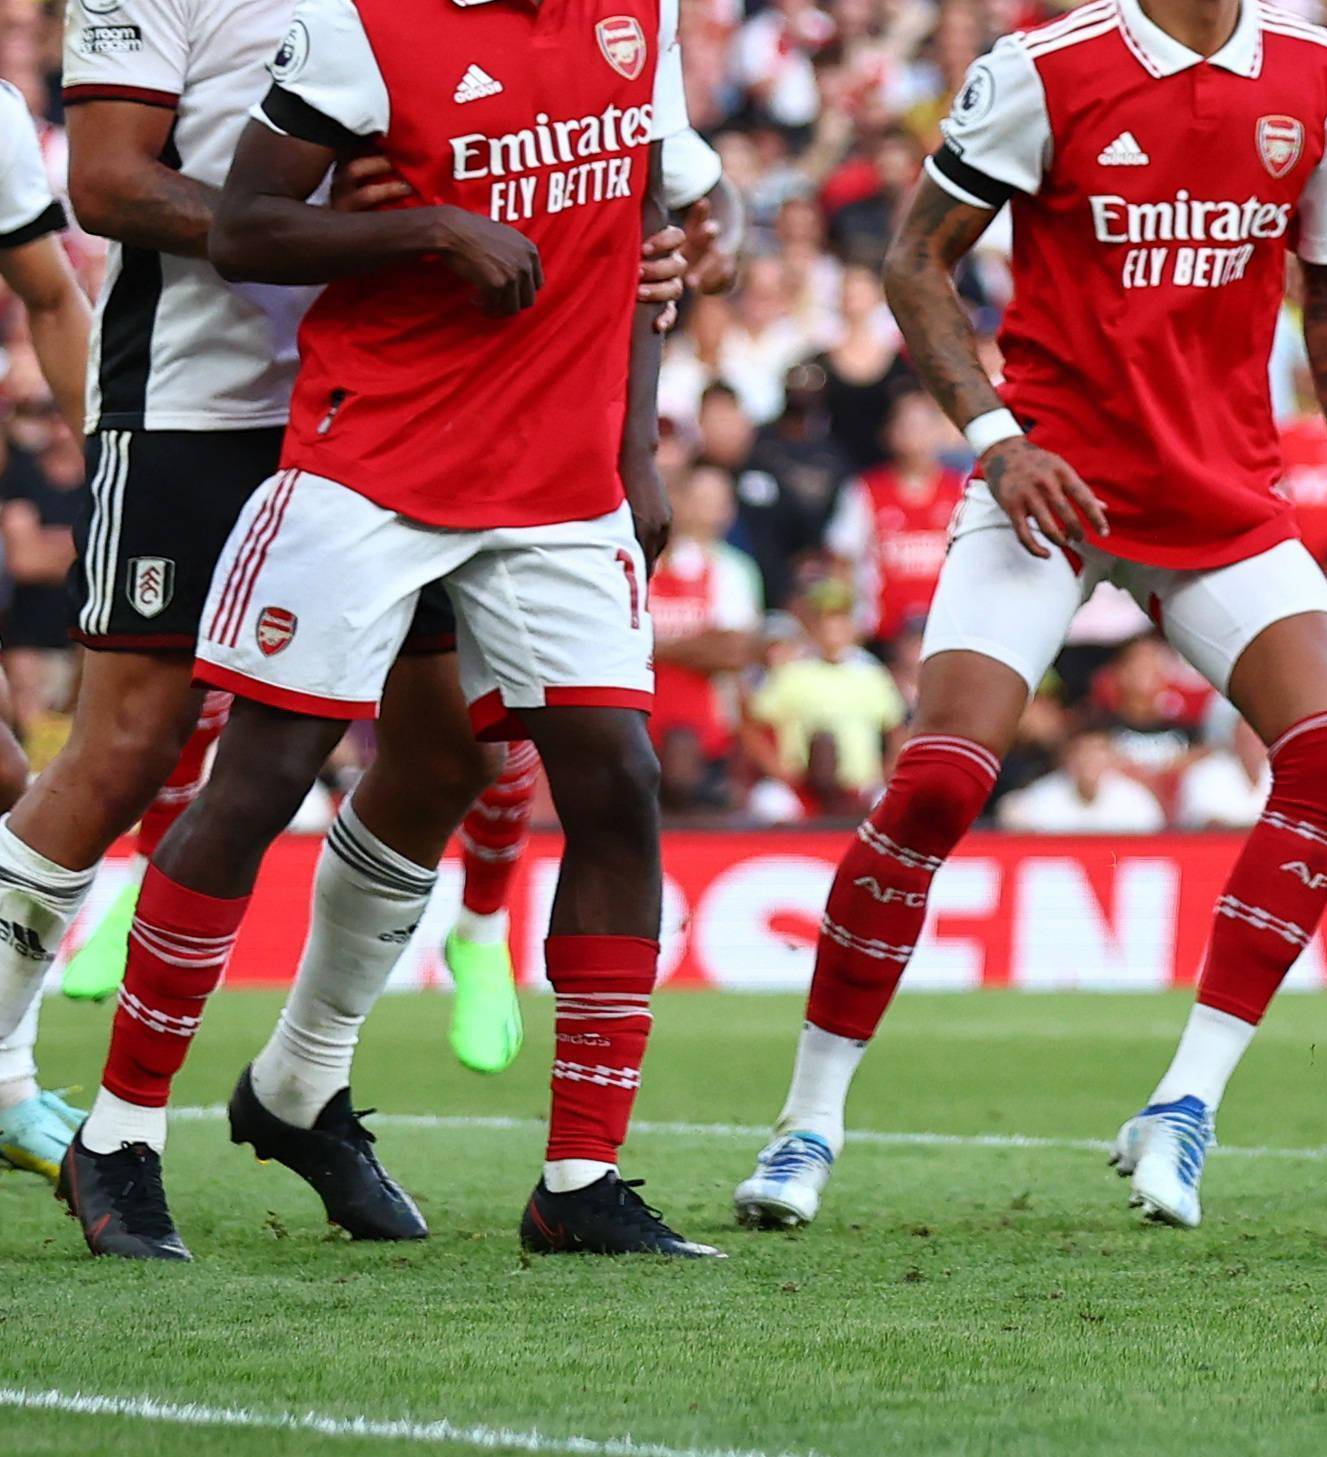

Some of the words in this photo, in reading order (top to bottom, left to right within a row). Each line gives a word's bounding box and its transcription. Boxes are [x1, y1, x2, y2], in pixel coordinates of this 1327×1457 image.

[448, 103, 654, 181] Emirates
[489, 175, 538, 223] FLY
[546, 156, 632, 214] BETTER
[1088, 188, 1292, 243] Emirates
[1122, 246, 1169, 289] FLY
[1173, 243, 1256, 288] BETTER
[853, 875, 927, 908] AFC
